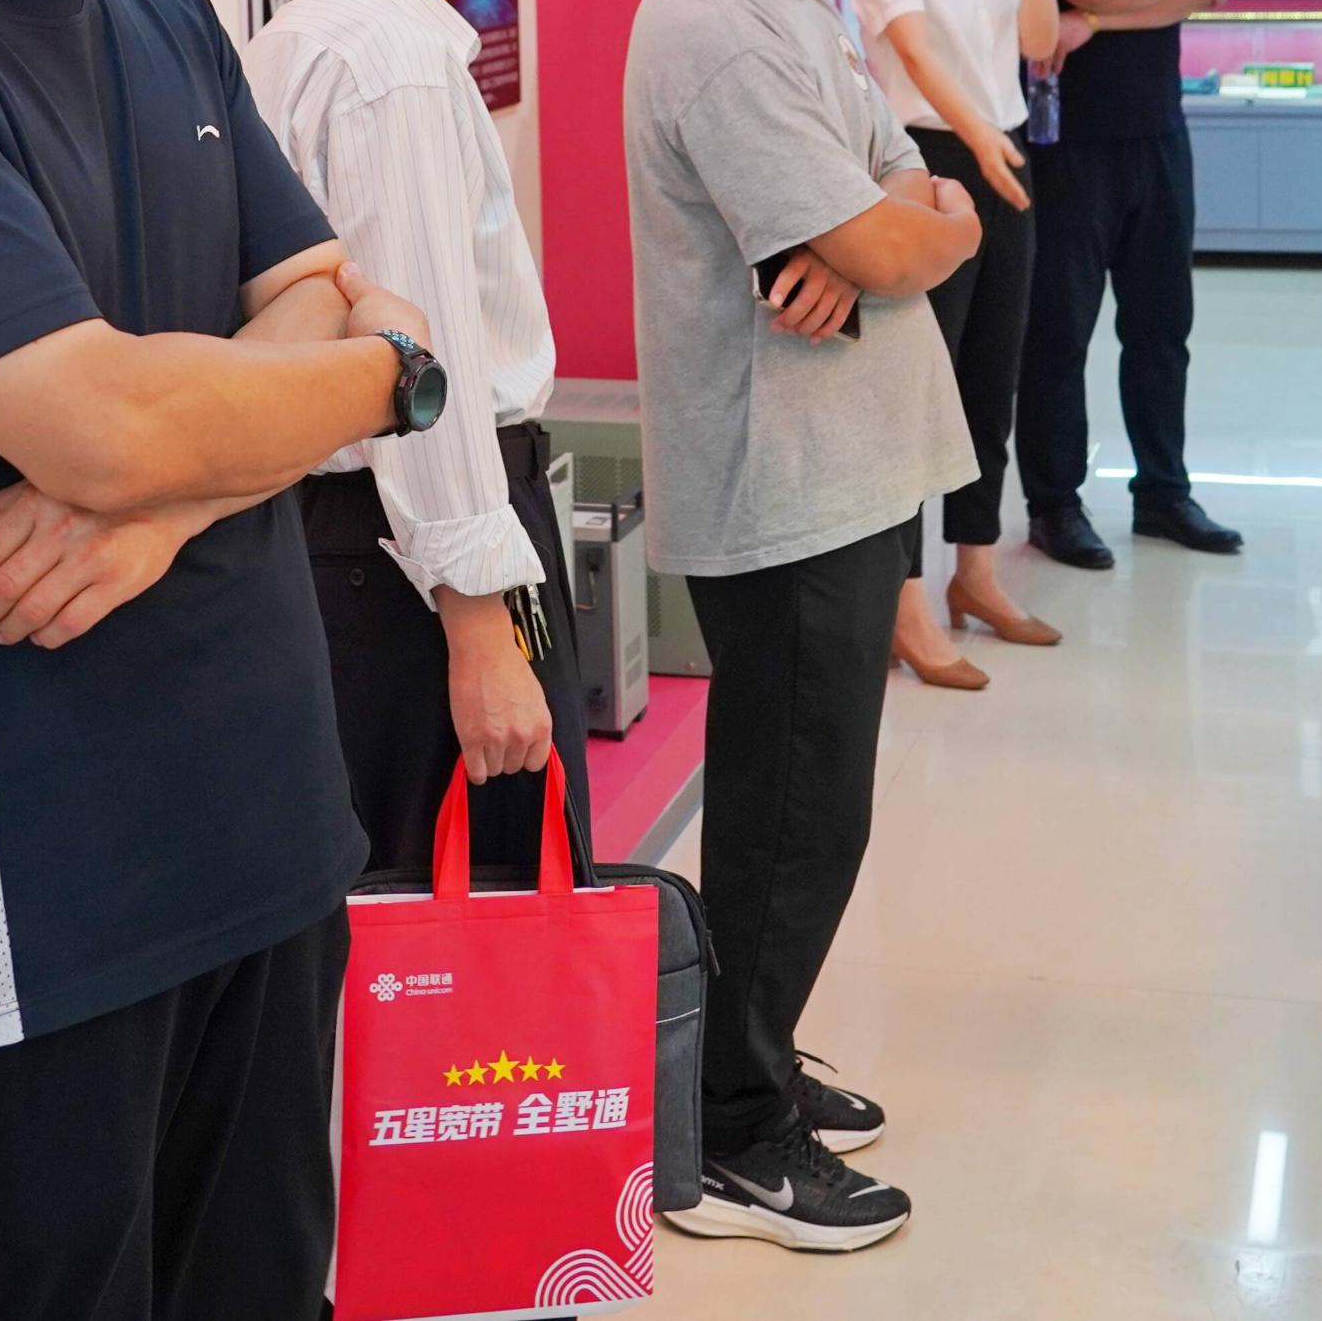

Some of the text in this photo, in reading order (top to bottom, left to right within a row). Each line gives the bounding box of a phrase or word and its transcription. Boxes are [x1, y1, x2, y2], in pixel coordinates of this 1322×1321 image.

[405, 972, 453, 986] 中国联通
[368, 1086, 631, 1146] 五星宽带 全墅通
